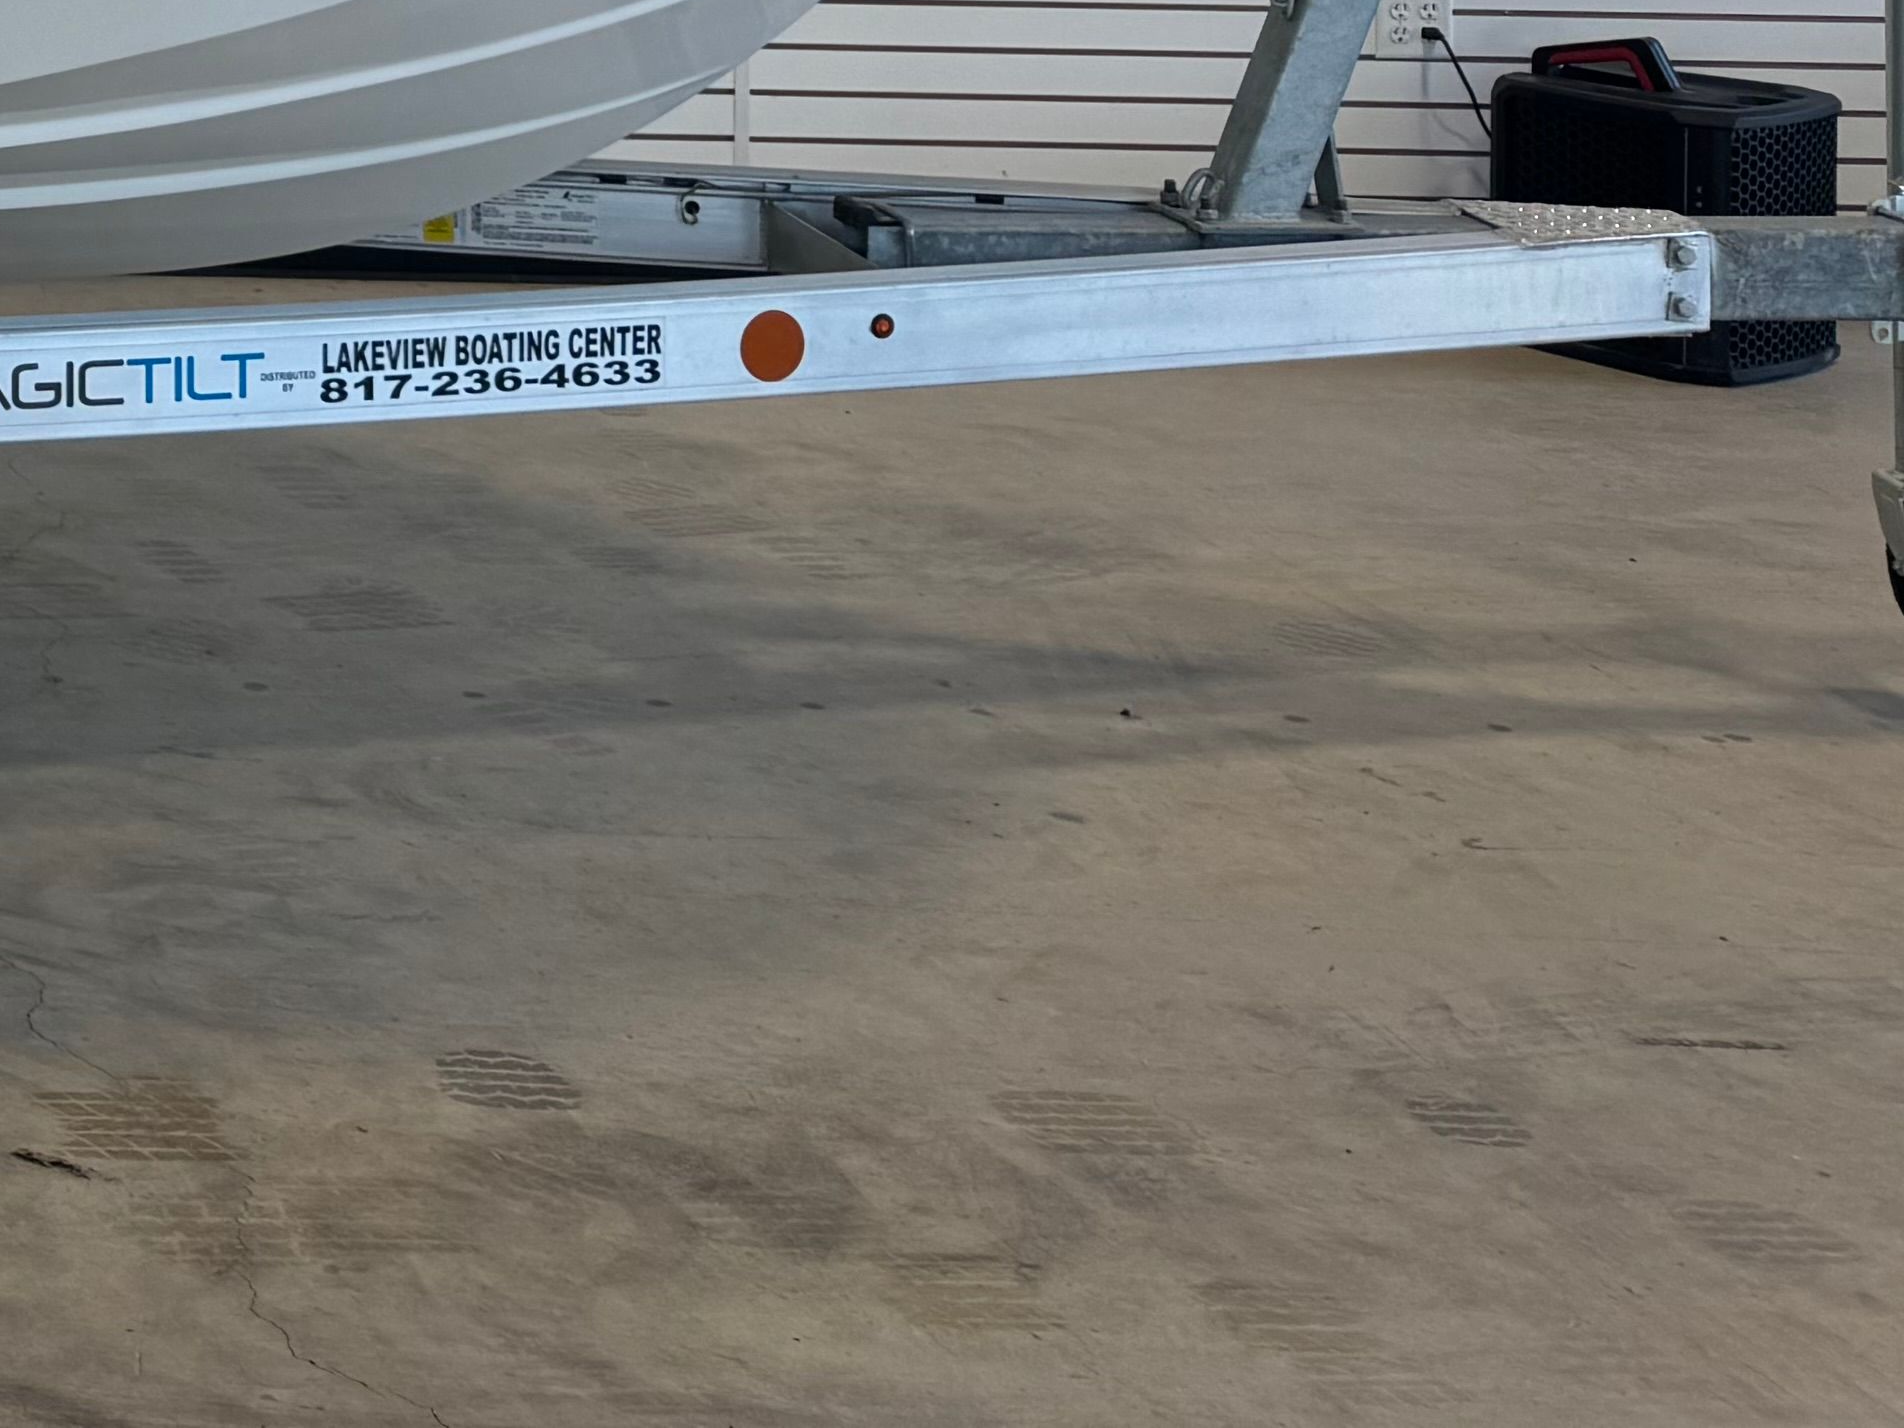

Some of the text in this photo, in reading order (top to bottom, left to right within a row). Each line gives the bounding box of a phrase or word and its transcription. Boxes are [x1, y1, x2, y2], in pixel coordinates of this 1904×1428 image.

[321, 323, 662, 374] LAKEVIEW BOATING CENTER
[259, 370, 317, 382] DISTRIBUTED
[281, 383, 294, 393] BY
[319, 358, 662, 404] 817-236-4633
